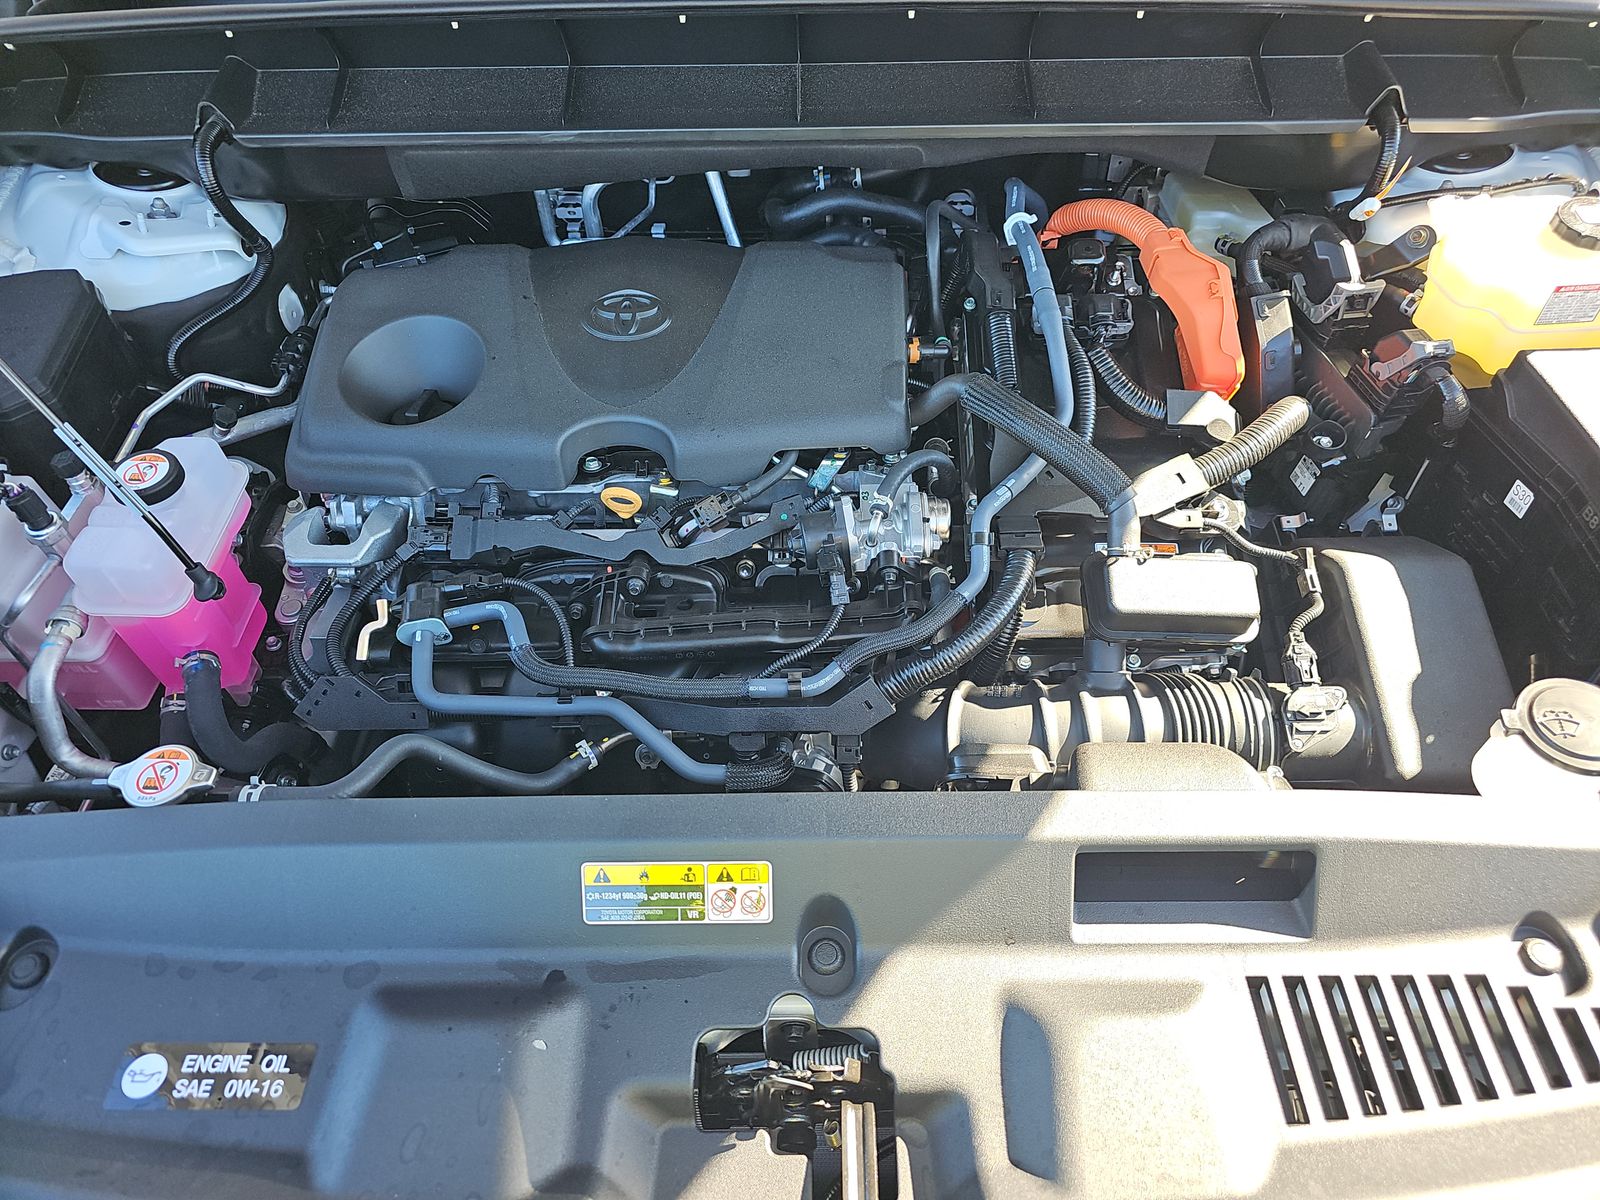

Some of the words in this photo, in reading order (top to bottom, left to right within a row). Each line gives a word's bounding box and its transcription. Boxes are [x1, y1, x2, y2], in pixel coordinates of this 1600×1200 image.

[1512, 484, 1532, 506] S30
[1582, 505, 1598, 529] B8
[687, 910, 699, 919] VR
[181, 1055, 252, 1074] ENGINE
[261, 1055, 290, 1073] OIL
[172, 1079, 214, 1098] SAE
[224, 1079, 285, 1098] 0W-16
